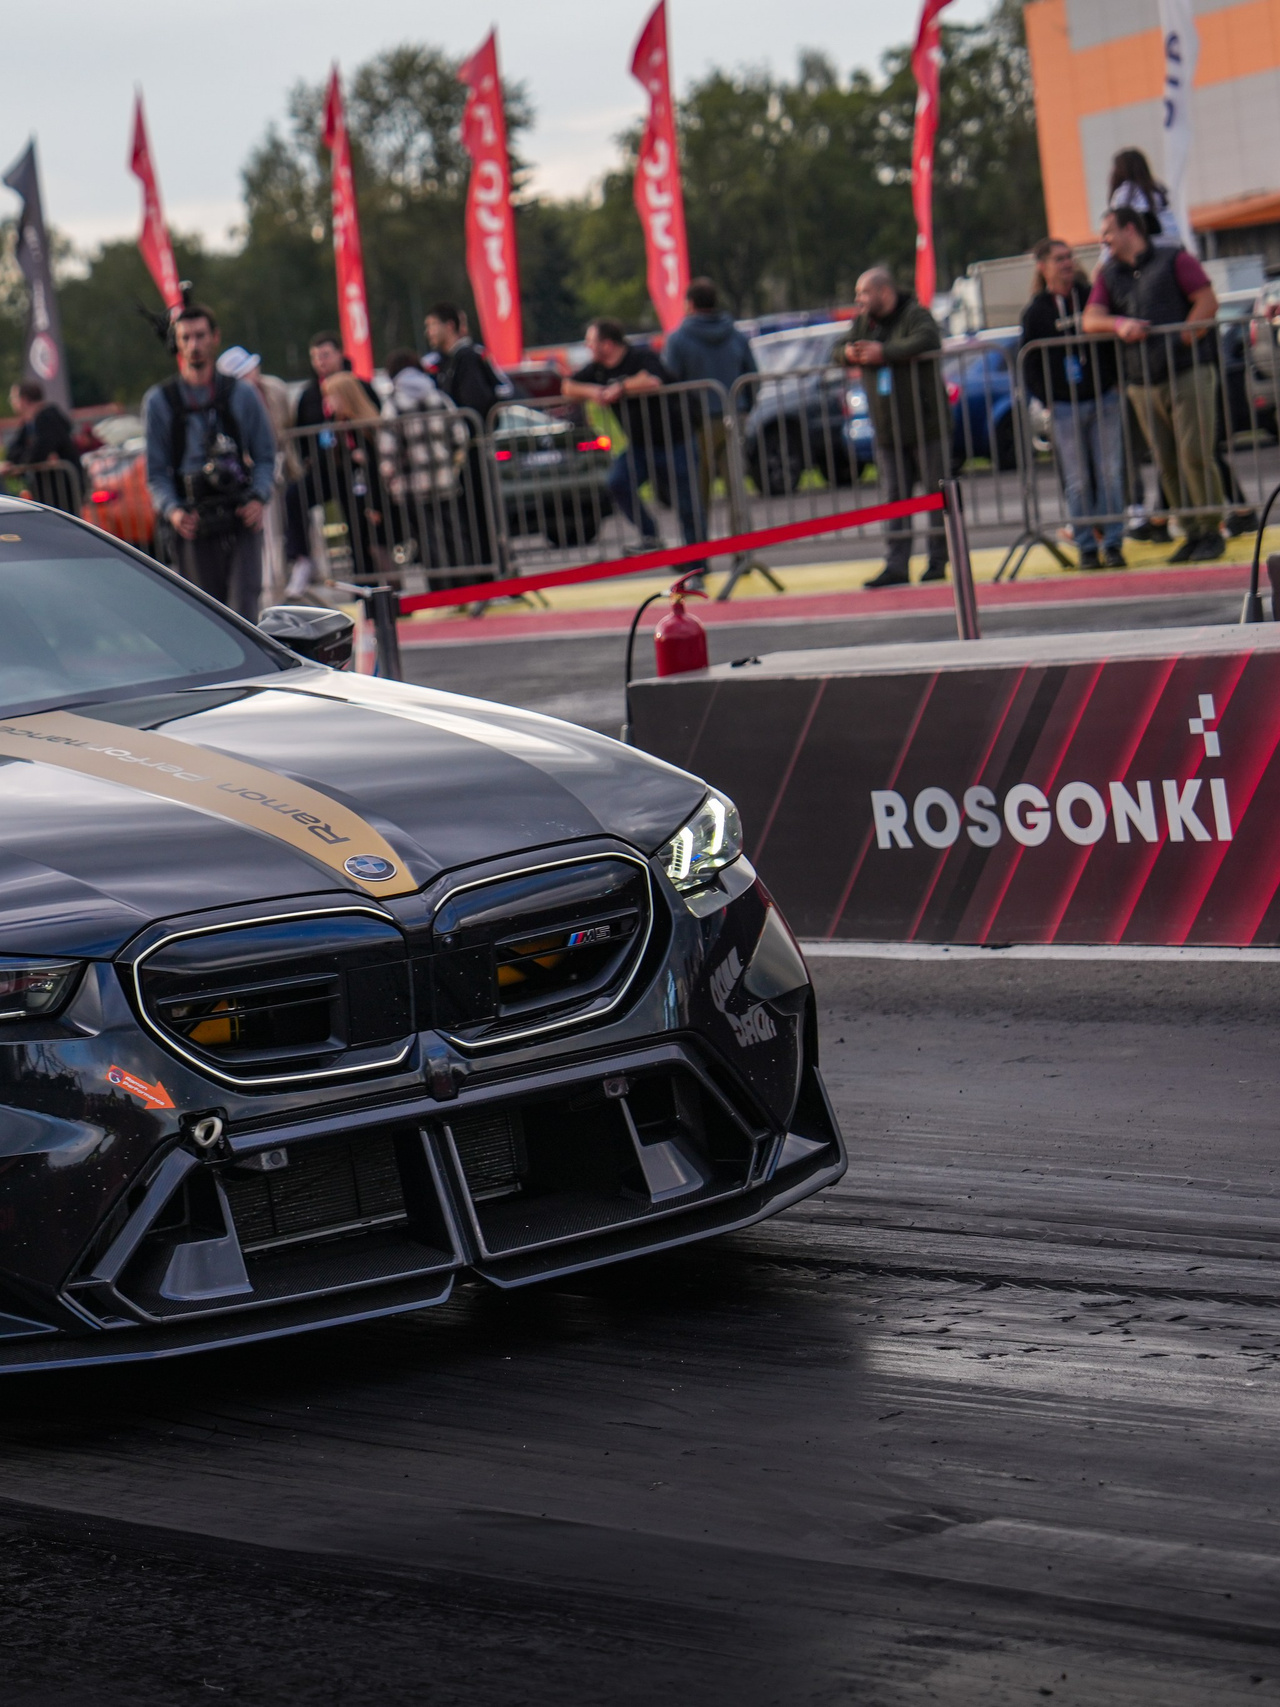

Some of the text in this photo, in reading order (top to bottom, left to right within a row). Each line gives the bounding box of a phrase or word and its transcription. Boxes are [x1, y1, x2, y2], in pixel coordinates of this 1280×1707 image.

[217, 782, 351, 845] Ramon
[870, 778, 1233, 850] ROSGONKI
[122, 1080, 165, 1106] Performance
[125, 1075, 148, 1091] Ramon
